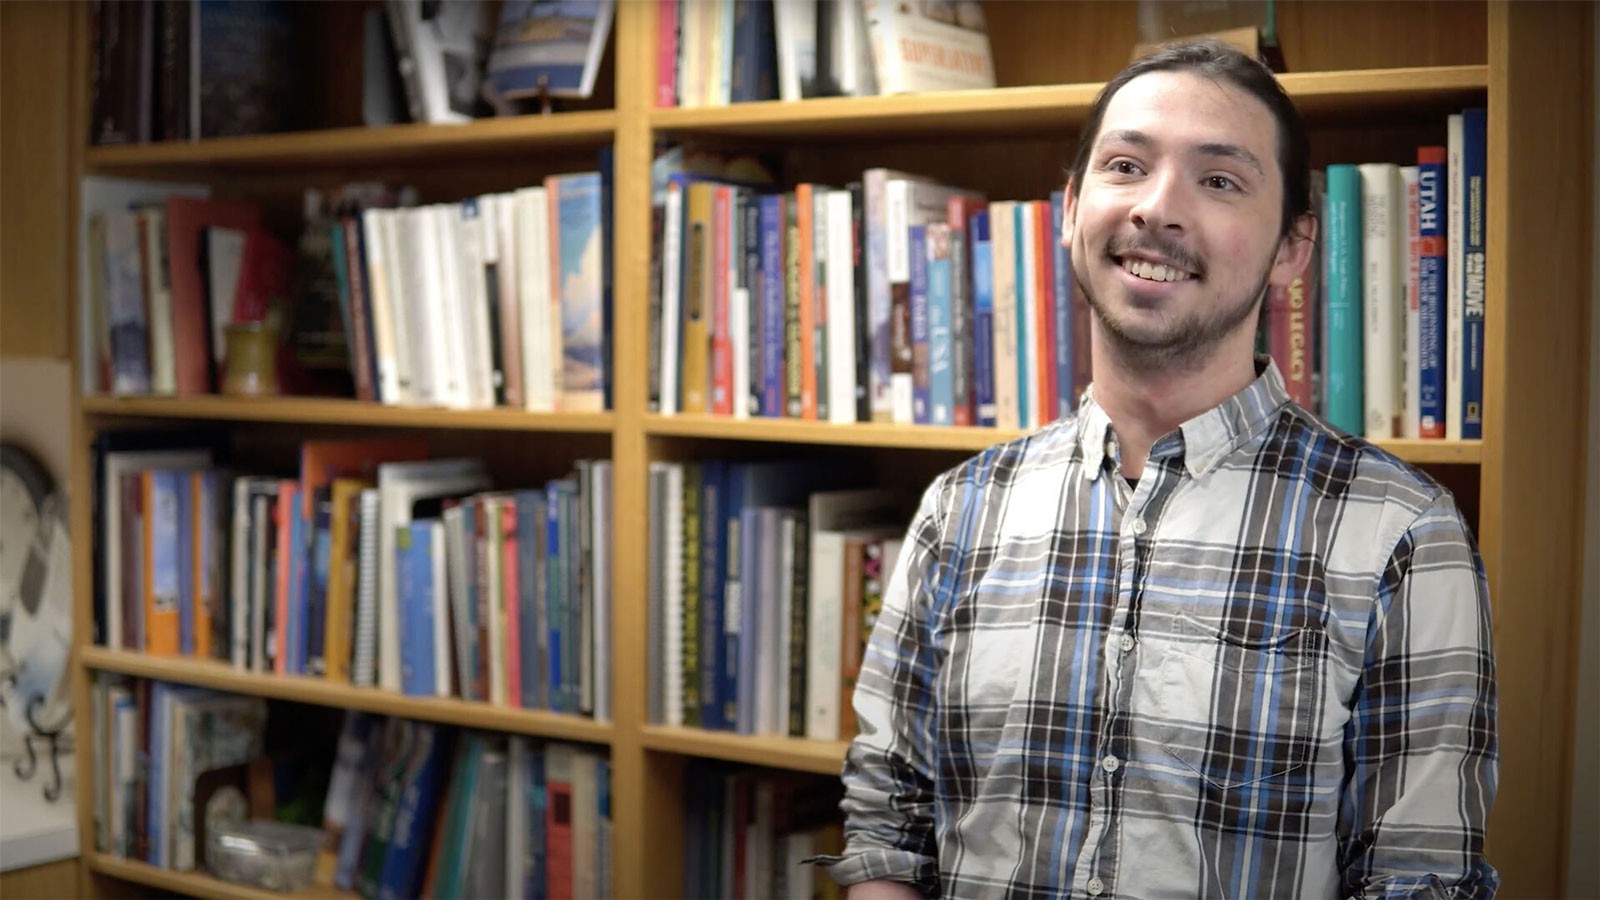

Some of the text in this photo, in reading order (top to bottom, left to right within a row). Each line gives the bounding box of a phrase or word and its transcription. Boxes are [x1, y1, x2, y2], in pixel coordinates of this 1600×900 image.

[1420, 170, 1437, 230] UTAH
[1465, 274, 1484, 317] MOVE
[930, 326, 949, 374] USA
[1289, 311, 1305, 382] LEGACY
